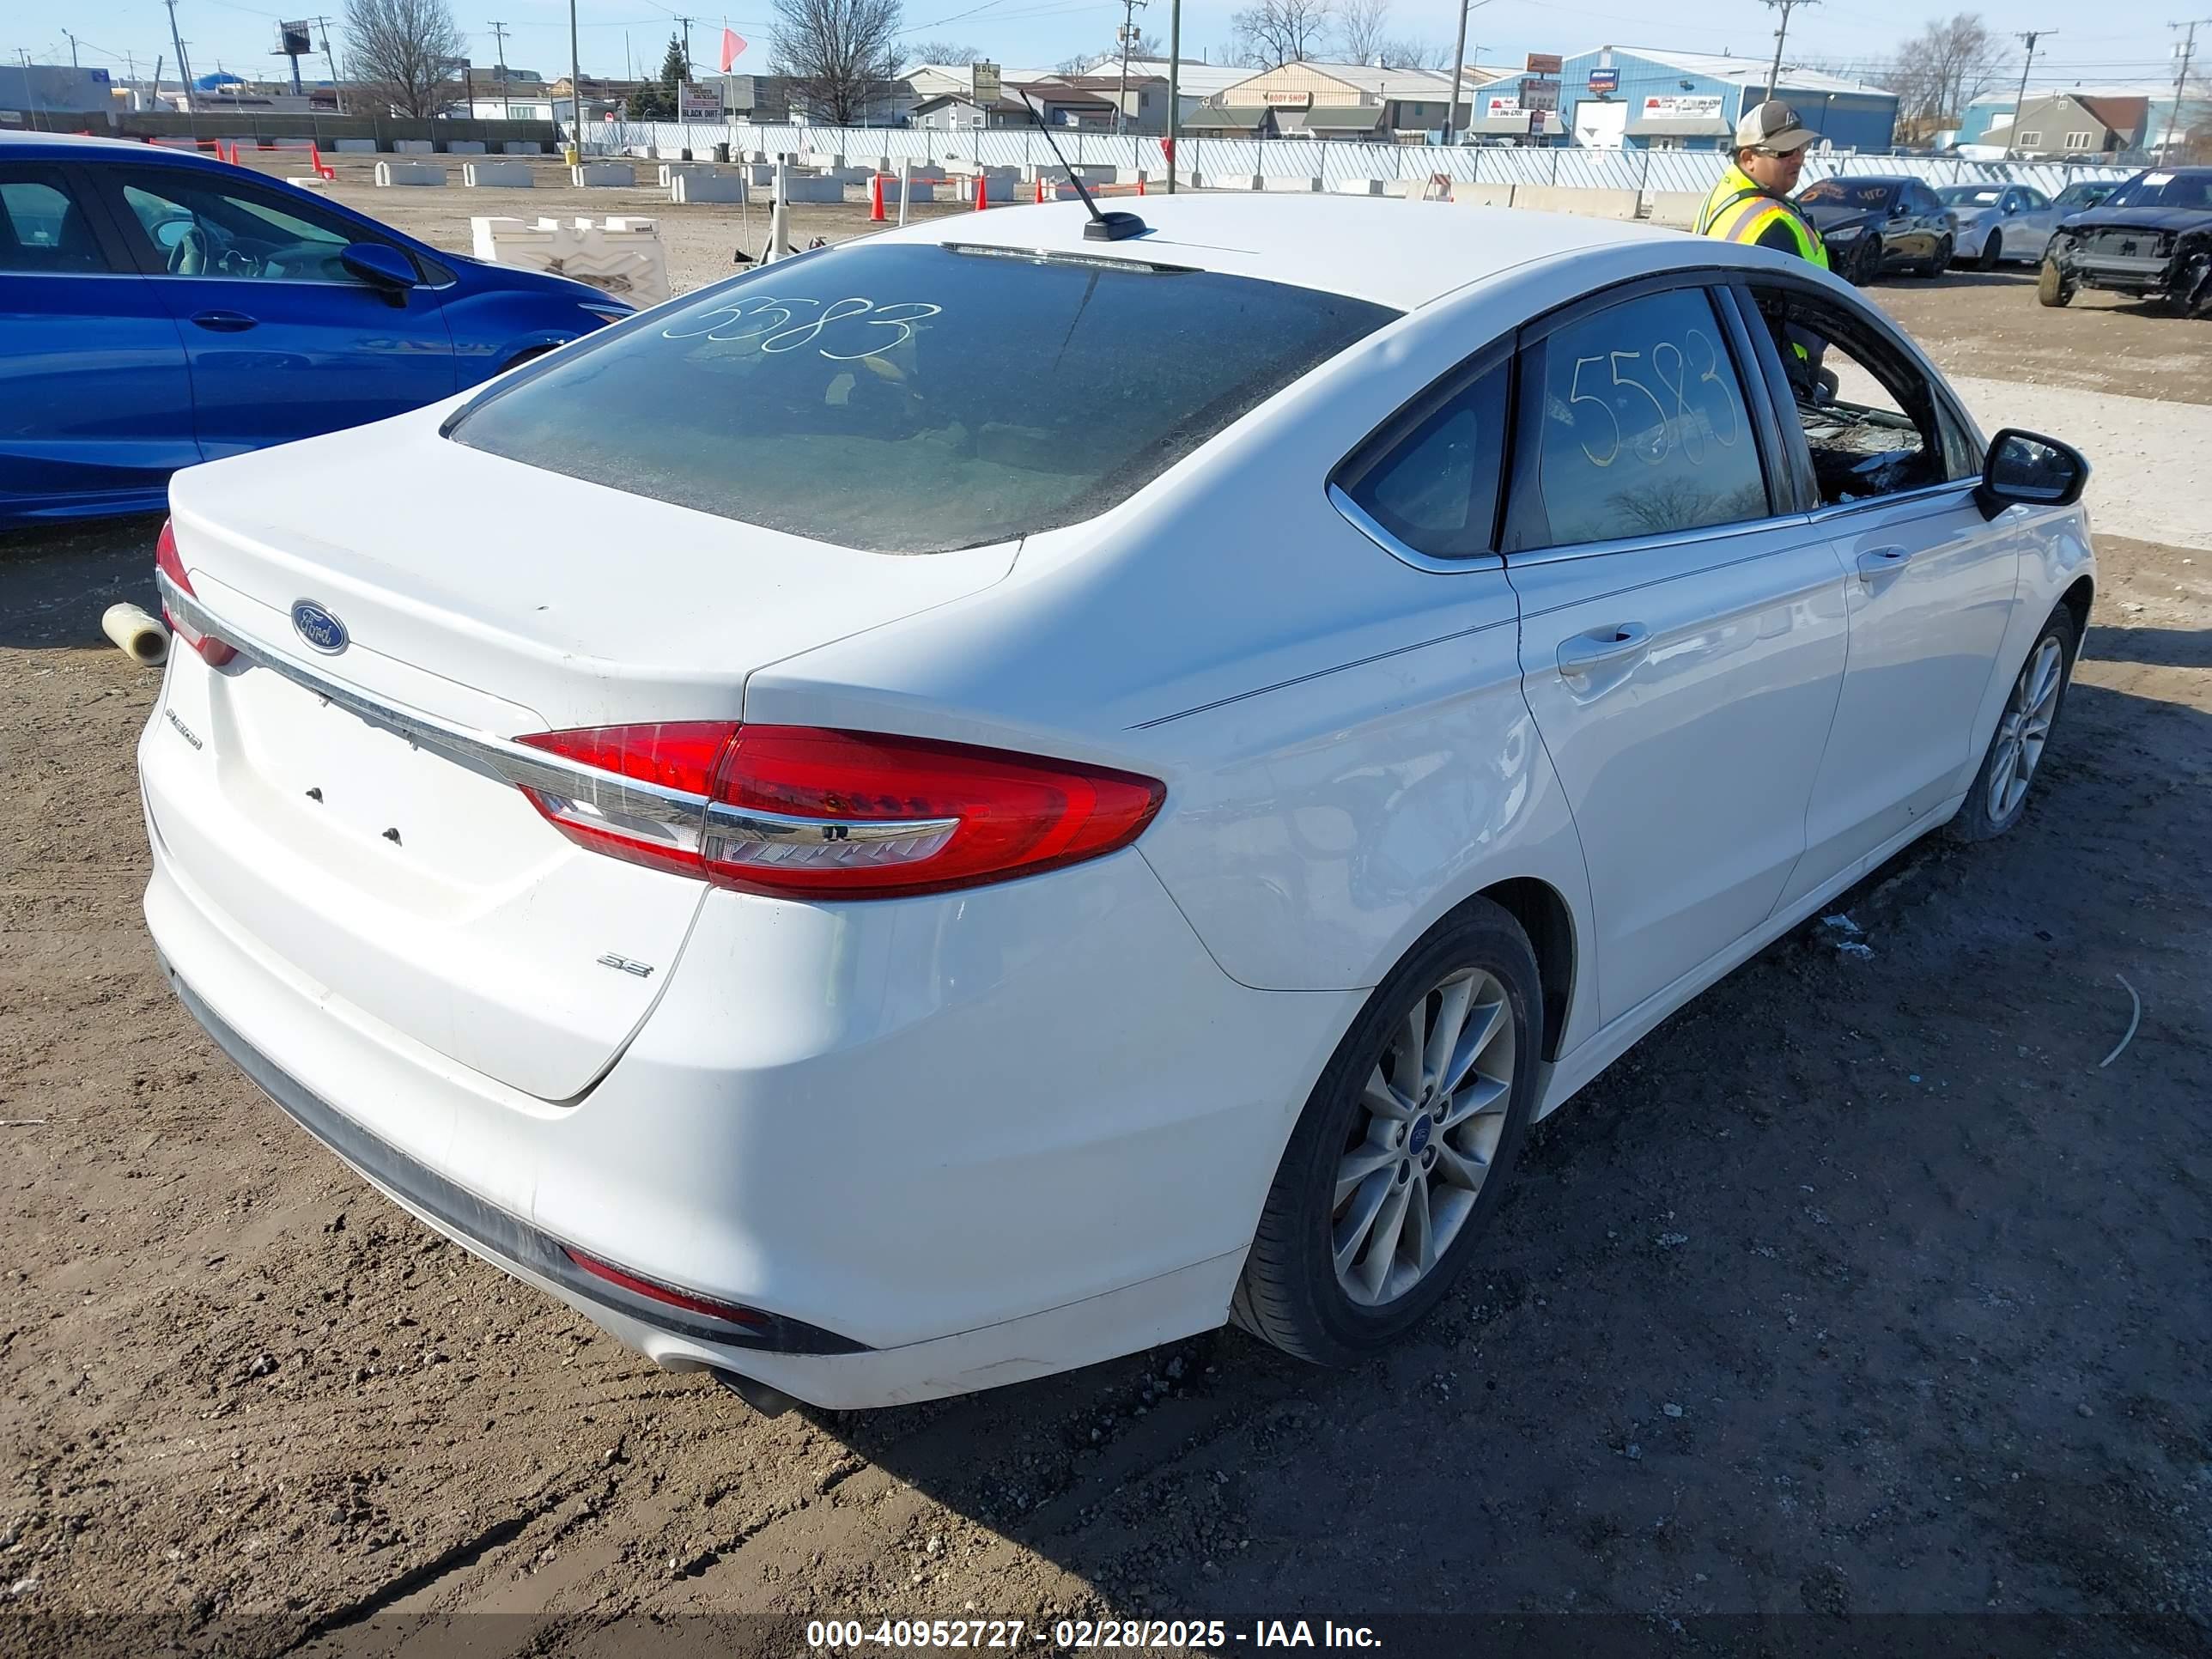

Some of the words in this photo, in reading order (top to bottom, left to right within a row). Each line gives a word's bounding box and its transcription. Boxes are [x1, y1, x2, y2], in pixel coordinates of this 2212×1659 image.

[682, 109, 702, 118] BLACK
[1269, 94, 1287, 103] BODY
[1288, 94, 1307, 103] SHOP
[662, 296, 942, 360] 5583
[1570, 329, 1738, 467] 5583
[301, 609, 332, 645] Ford
